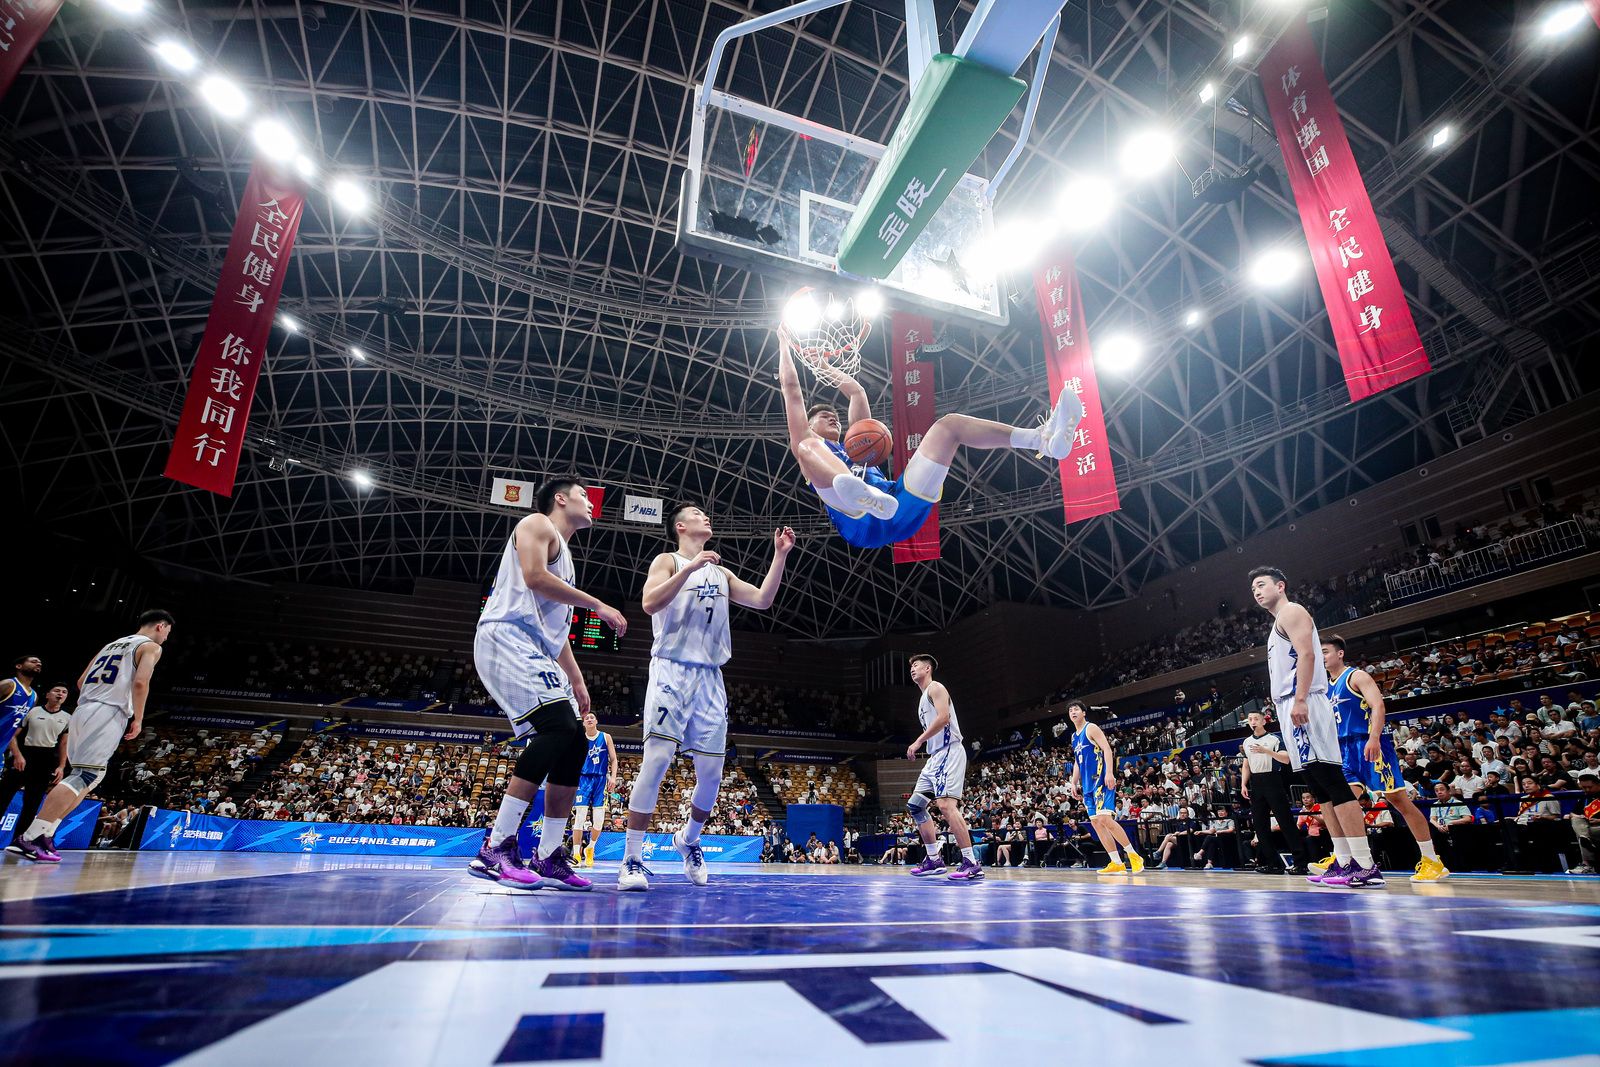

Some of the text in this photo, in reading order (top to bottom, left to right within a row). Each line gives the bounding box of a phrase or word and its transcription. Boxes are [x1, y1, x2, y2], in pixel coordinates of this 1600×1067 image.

[878, 167, 948, 260] 金陵
[1281, 64, 1384, 335] 体育强国 全民健身
[192, 198, 289, 467] 全民健身 你我同行
[1045, 264, 1097, 477] 体育惠民 健生活
[639, 506, 658, 517] NBL
[705, 606, 714, 624] 7
[84, 654, 124, 685] 25
[657, 706, 669, 726] 7
[328, 836, 437, 847] 2025年NBL全明星周末
